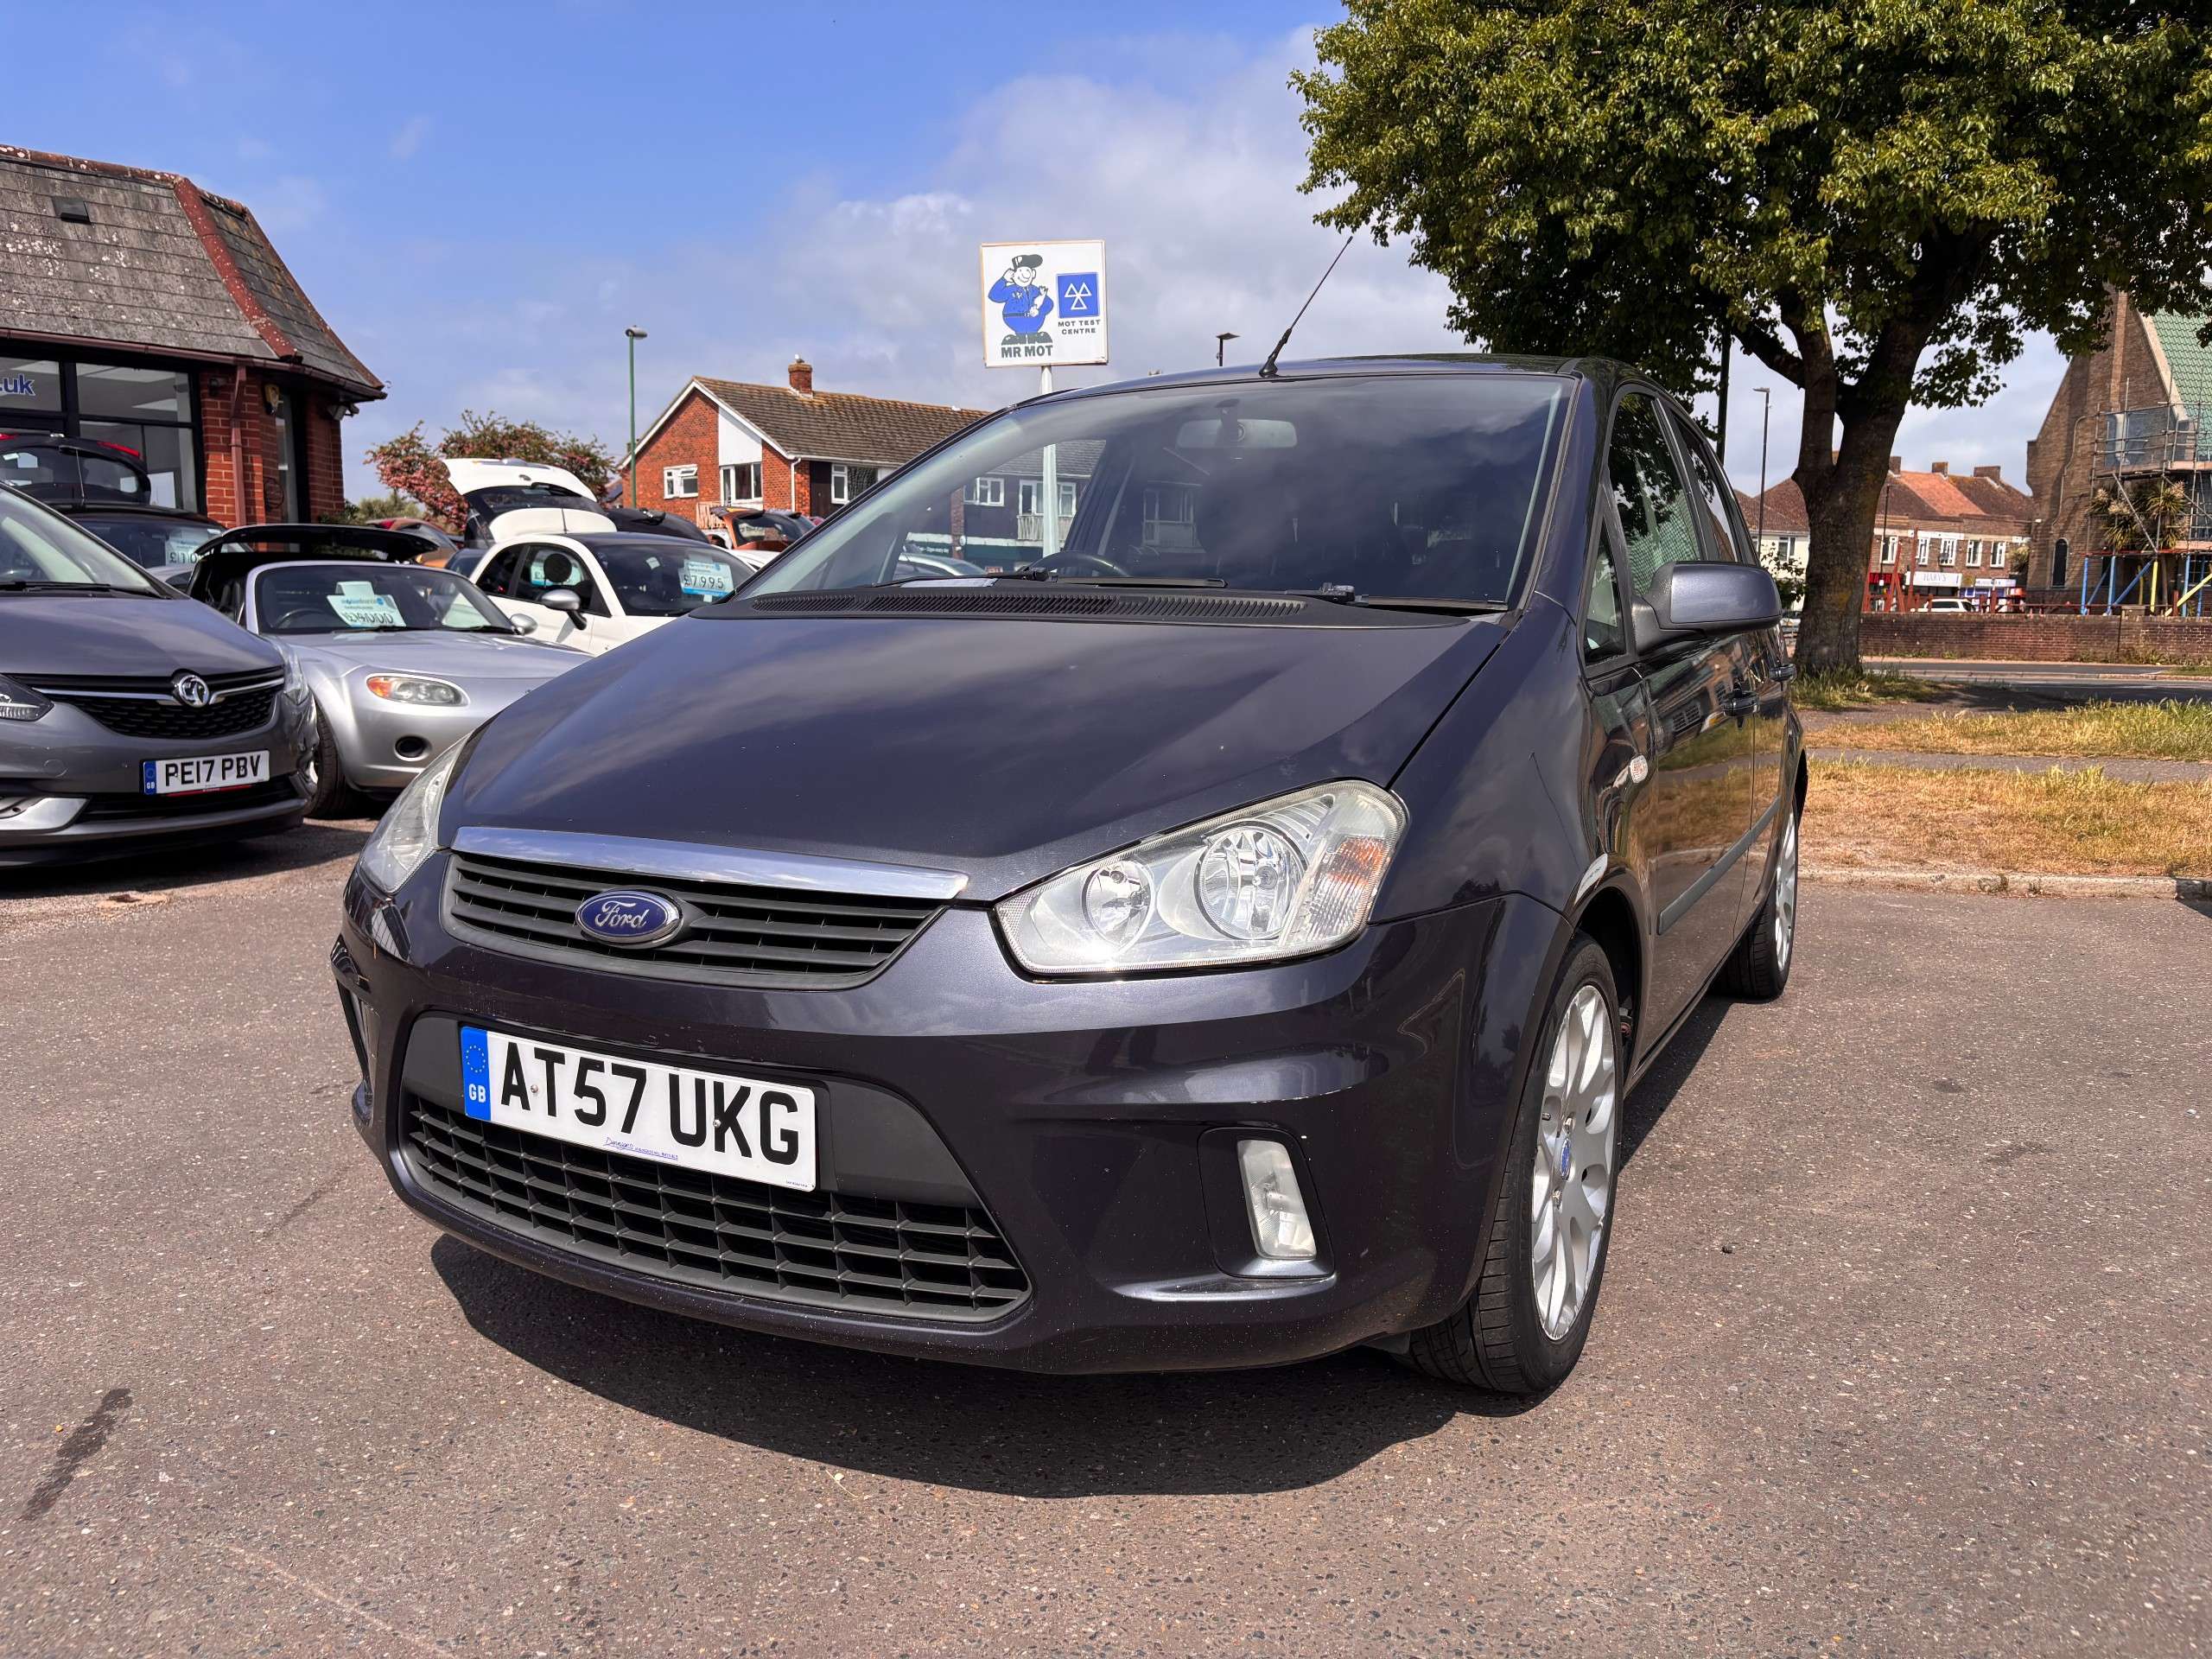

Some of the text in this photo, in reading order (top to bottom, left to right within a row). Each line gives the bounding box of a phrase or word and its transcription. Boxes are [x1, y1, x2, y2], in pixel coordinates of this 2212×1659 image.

[1001, 346, 1052, 358] MR MOT
[683, 575, 724, 588] £7995
[165, 754, 261, 786] PE17 PBV
[594, 900, 650, 928] Ford
[468, 1084, 486, 1103] GB
[500, 1041, 798, 1166] AT57 UKG
